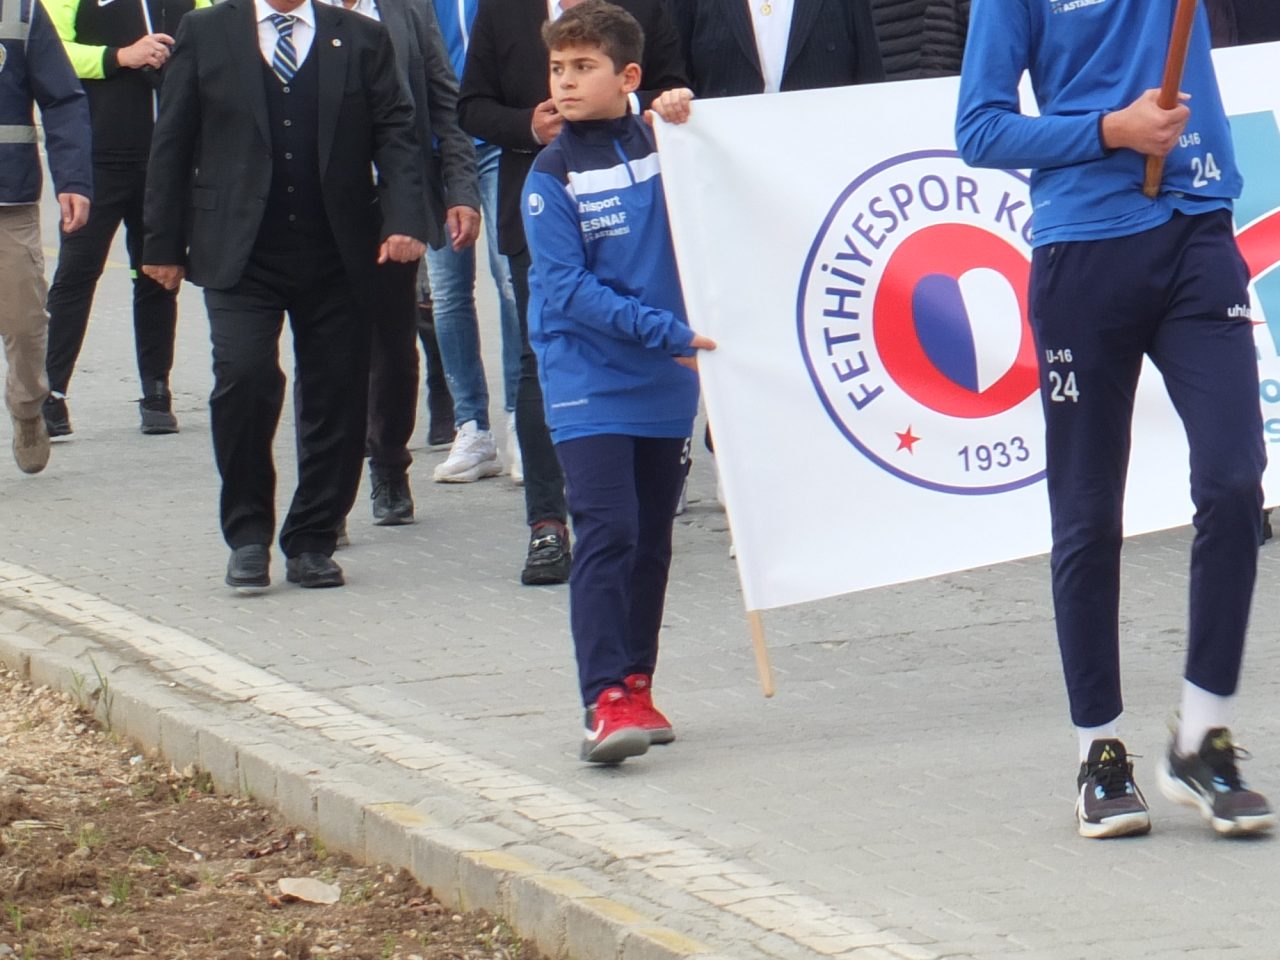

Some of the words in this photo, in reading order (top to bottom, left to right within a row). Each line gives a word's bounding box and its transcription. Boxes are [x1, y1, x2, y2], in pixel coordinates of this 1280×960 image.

[1179, 132, 1201, 148] U-16
[1191, 152, 1222, 188] 24
[578, 195, 622, 213] hlsport
[581, 212, 627, 232] ESNAF
[821, 174, 981, 411] FETHİYESPOR
[1045, 348, 1073, 364] U-16
[1048, 370, 1080, 403] 24
[957, 436, 1030, 472] 1933
